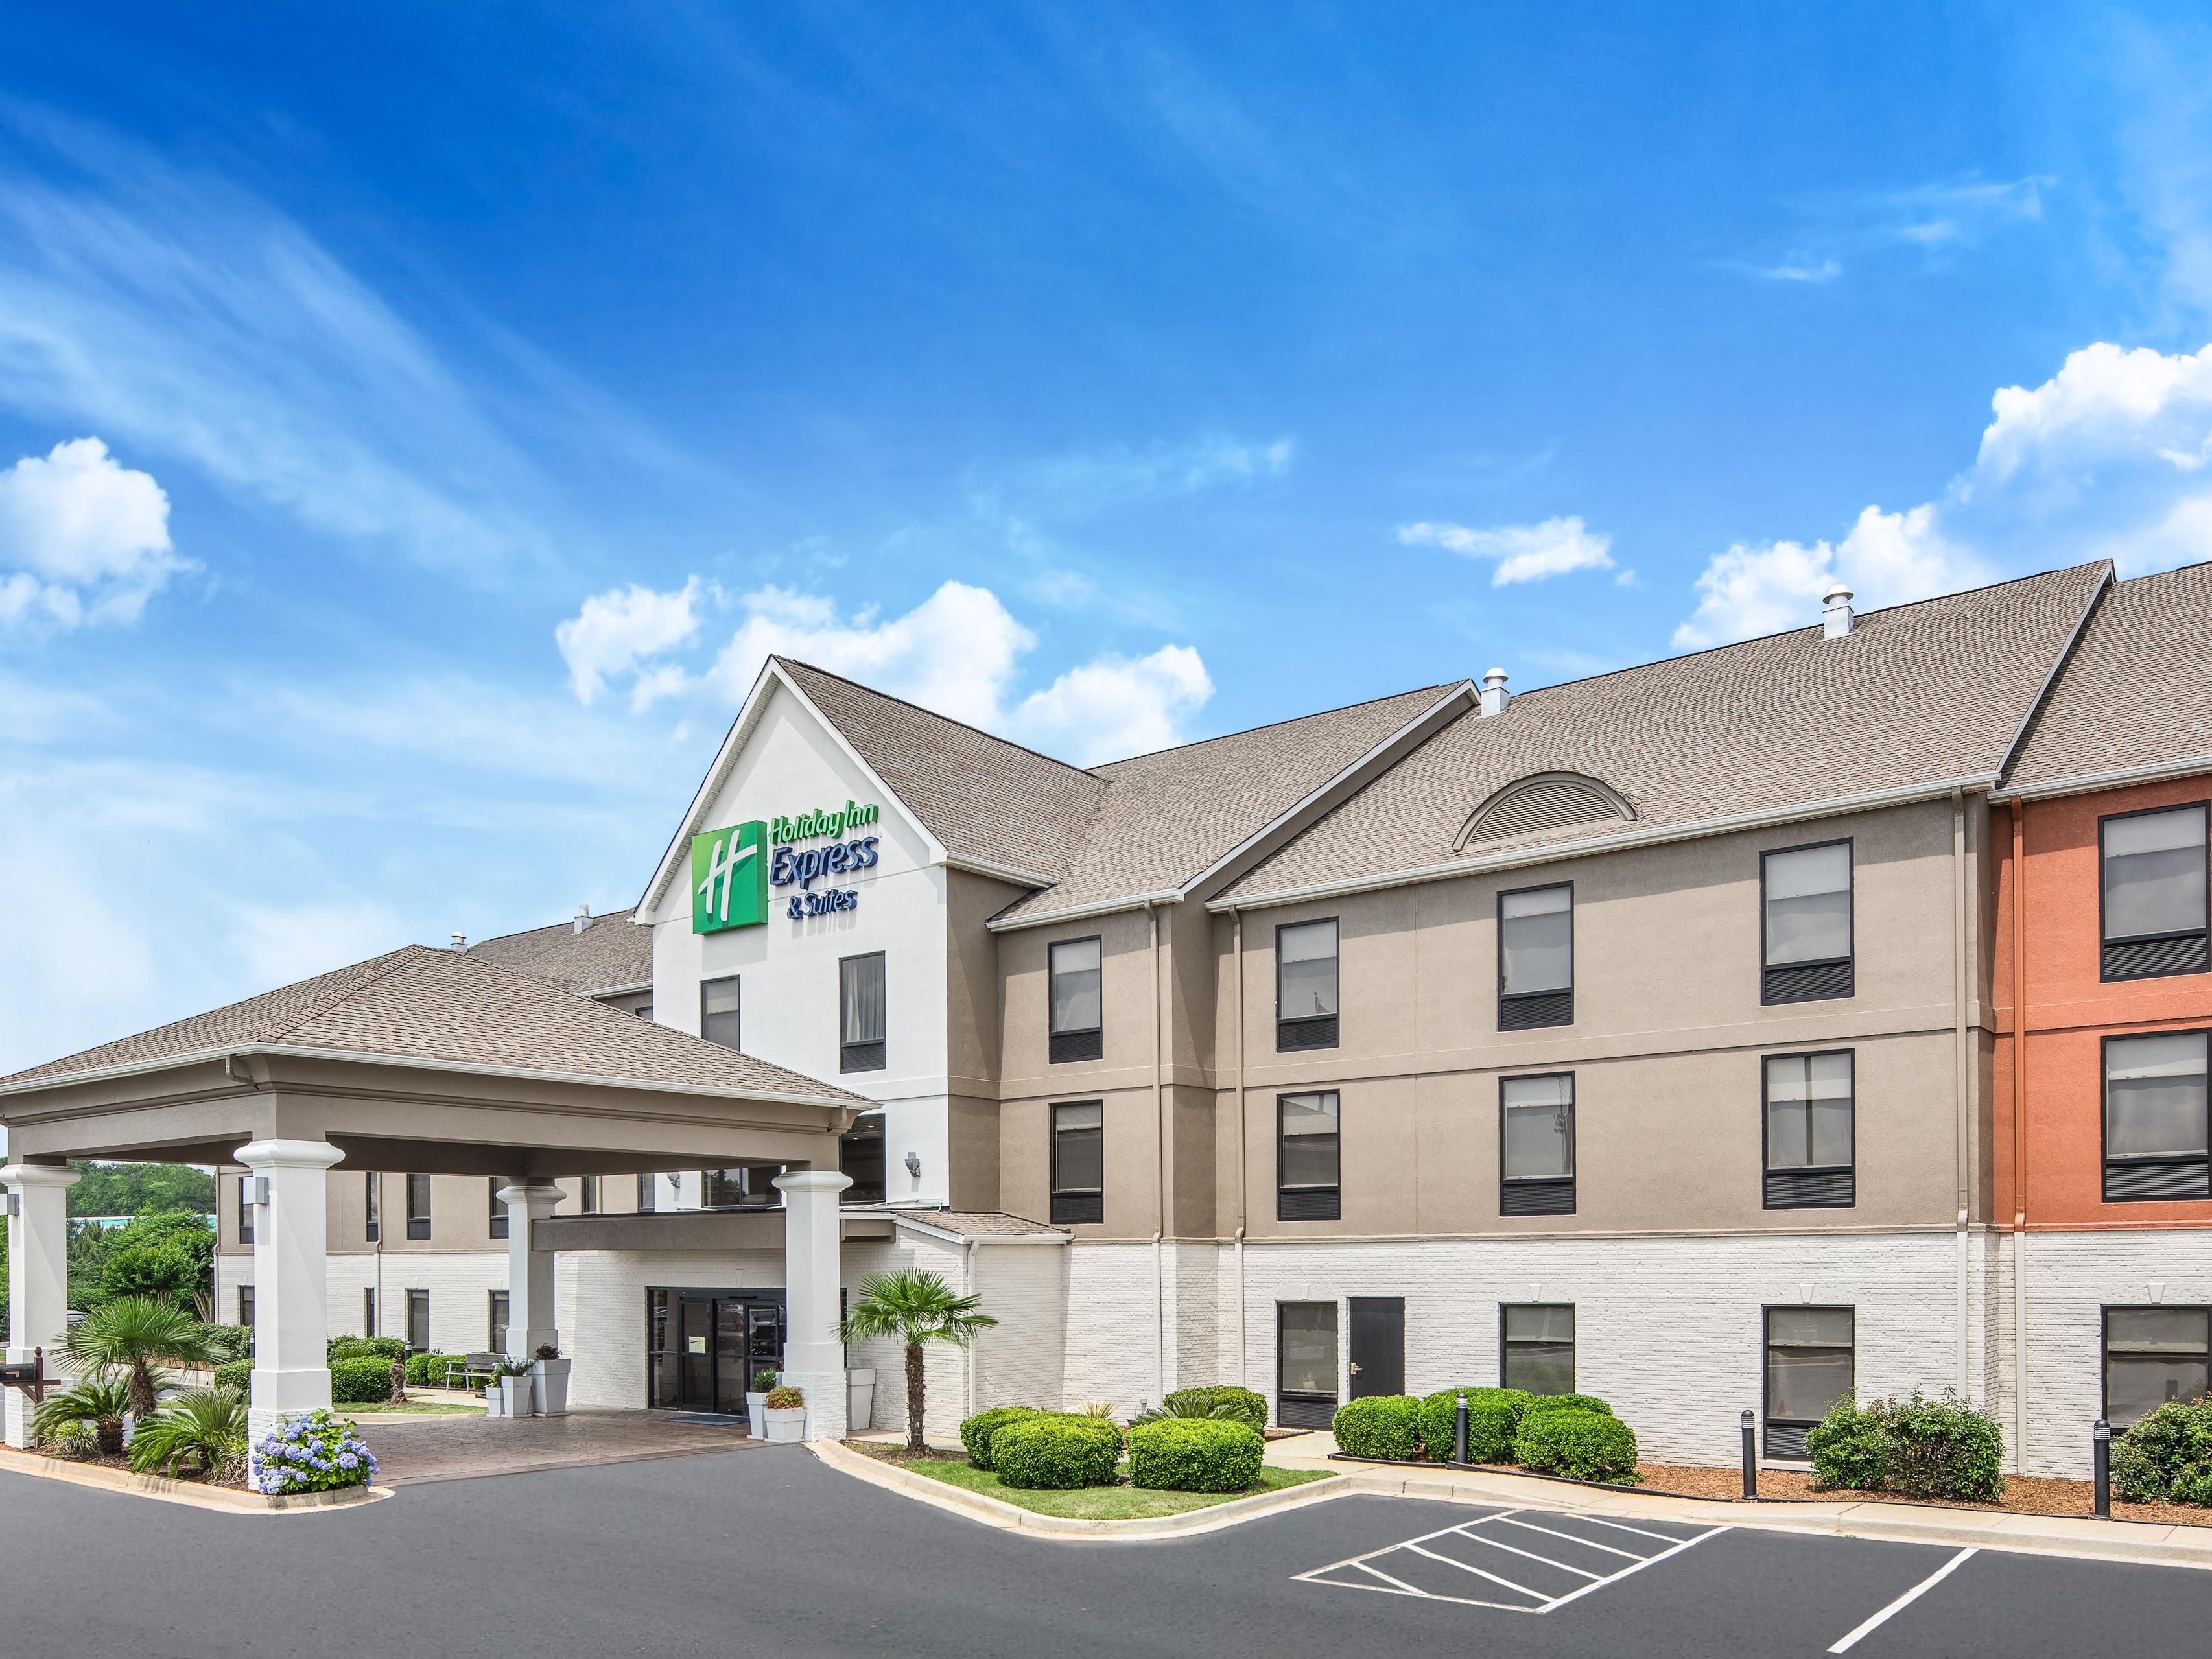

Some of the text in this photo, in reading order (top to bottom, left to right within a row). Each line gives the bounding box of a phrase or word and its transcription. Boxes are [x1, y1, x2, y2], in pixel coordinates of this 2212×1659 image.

[769, 799, 879, 845] Holiday Inn
[770, 836, 879, 890] Express
[787, 889, 858, 919] & Suites
